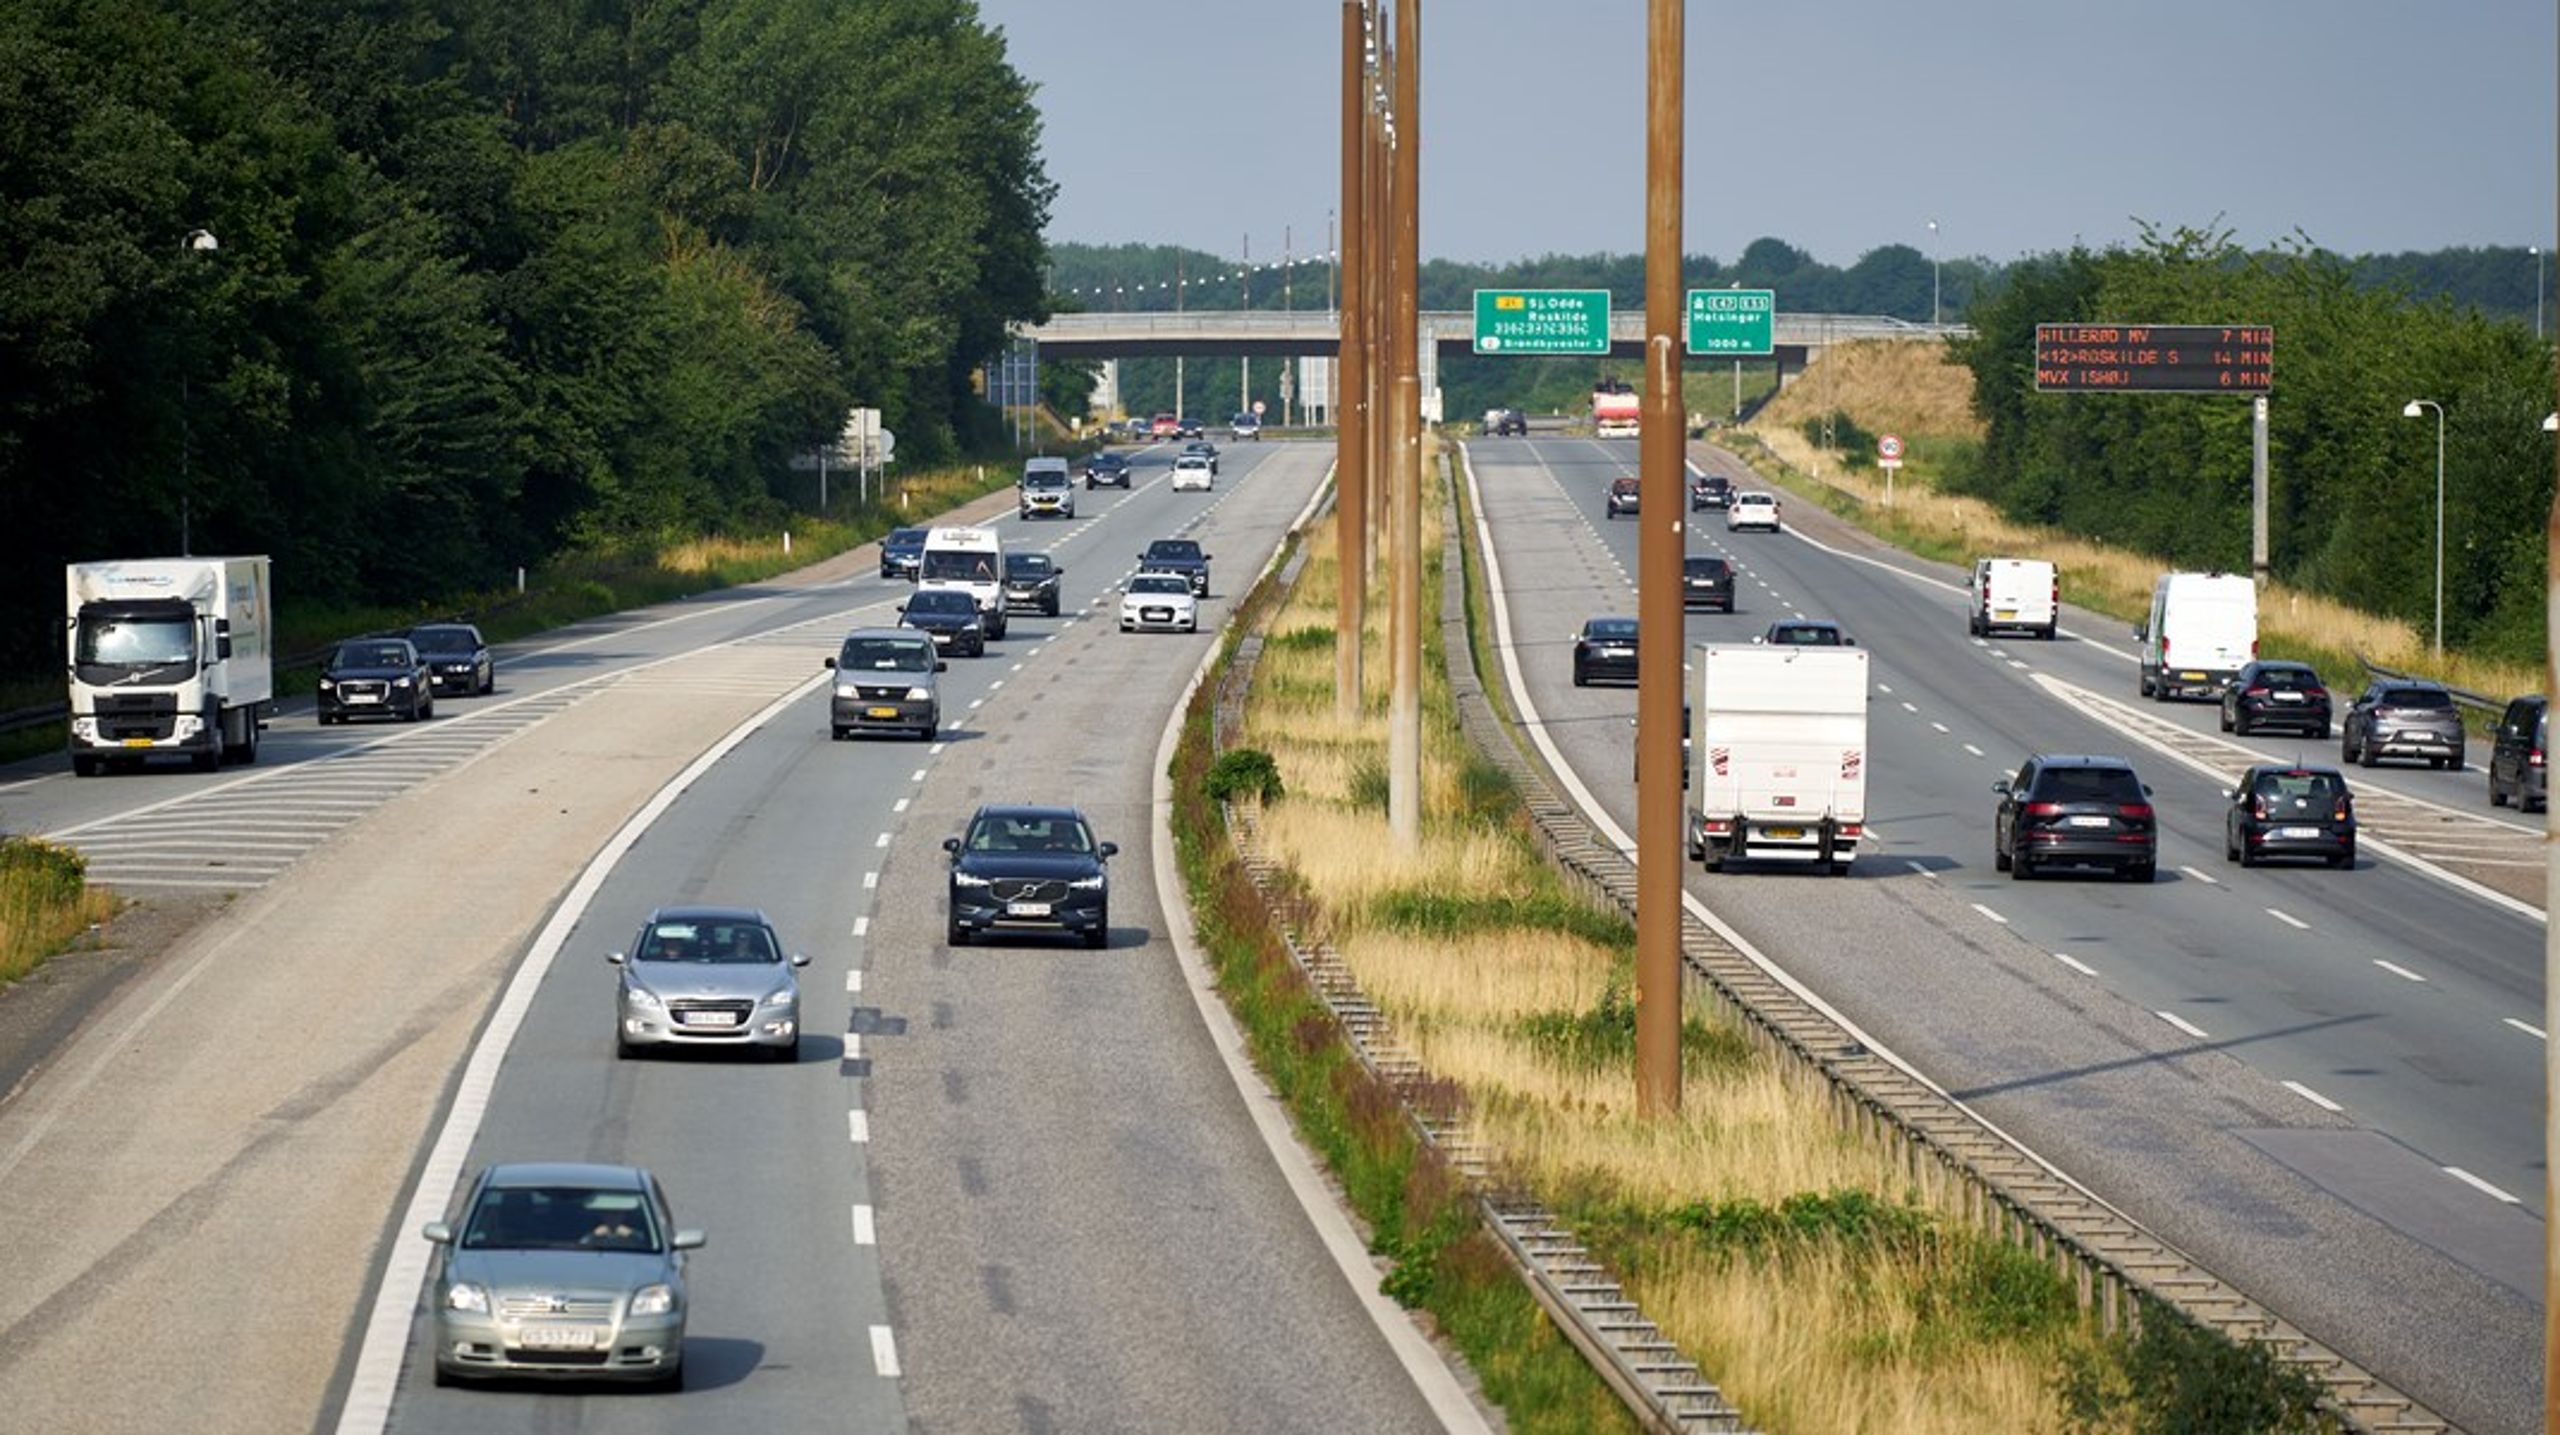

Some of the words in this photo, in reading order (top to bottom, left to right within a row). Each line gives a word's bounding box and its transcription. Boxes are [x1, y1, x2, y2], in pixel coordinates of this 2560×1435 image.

[1528, 311, 1588, 322] Roskilde
[2039, 329, 2119, 343] HILLERØD
[2128, 329, 2150, 343] MV
[2222, 329, 2233, 343] 7
[2241, 329, 2273, 344] MIN
[2167, 349, 2179, 365] S
[2214, 350, 2233, 365] 14
[2241, 351, 2273, 365] MIN
[2241, 371, 2273, 385] MIN
